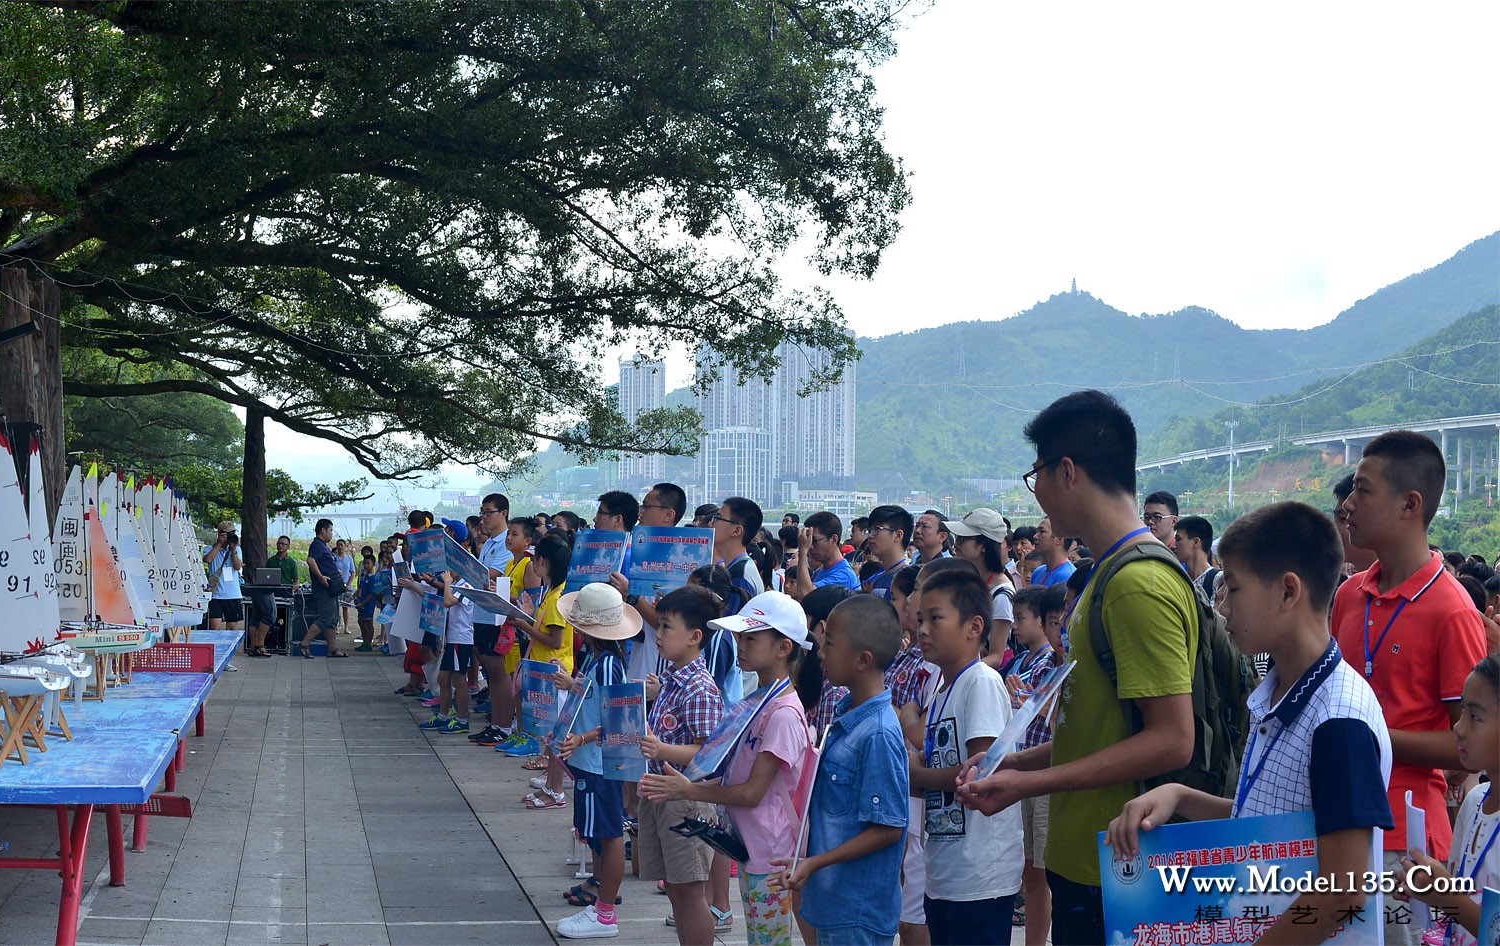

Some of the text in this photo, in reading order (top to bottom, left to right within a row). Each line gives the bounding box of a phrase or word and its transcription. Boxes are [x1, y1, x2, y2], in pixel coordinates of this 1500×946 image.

[61, 517, 78, 537] 闽
[54, 559, 83, 576] 053
[159, 569, 176, 579] 07
[7, 575, 31, 593] 91
[44, 573, 55, 588] 92
[95, 635, 114, 643] Mini
[1147, 839, 1318, 869] 2016年福建省青少年航海模型
